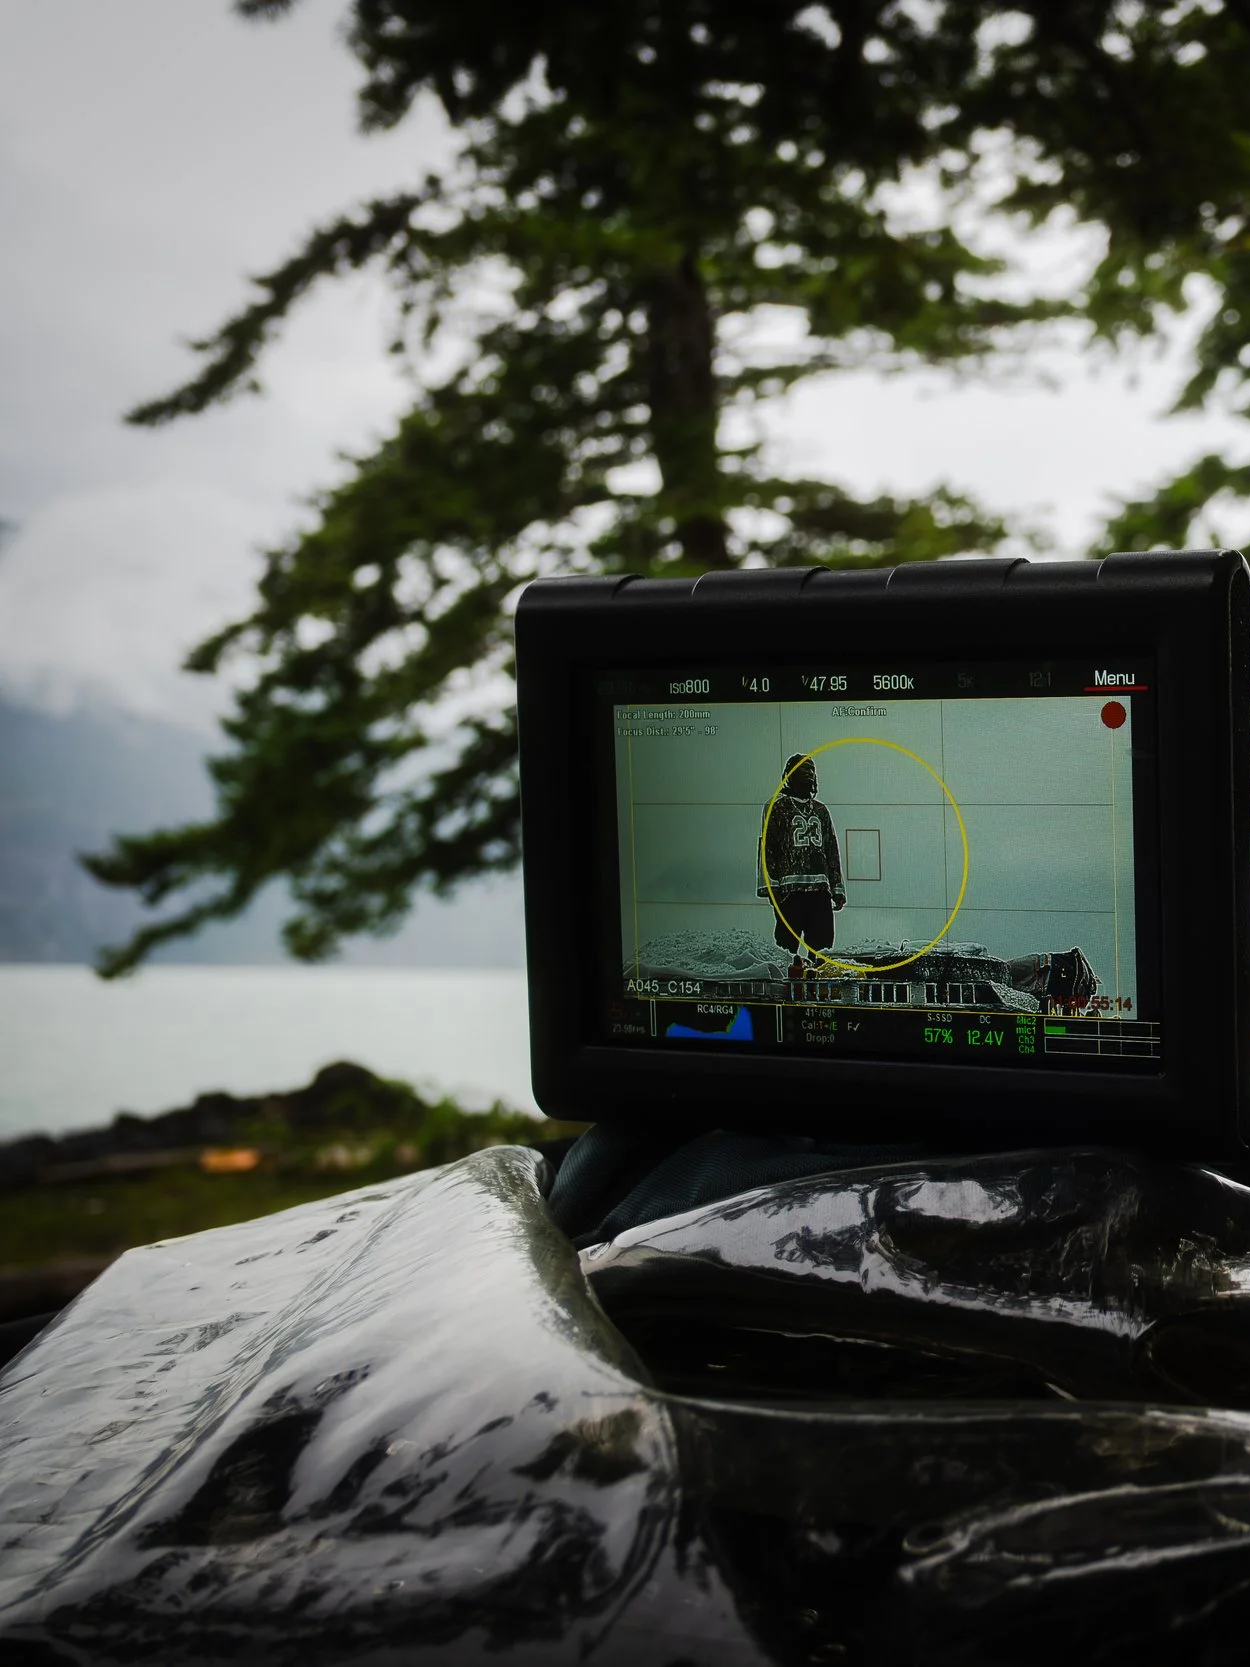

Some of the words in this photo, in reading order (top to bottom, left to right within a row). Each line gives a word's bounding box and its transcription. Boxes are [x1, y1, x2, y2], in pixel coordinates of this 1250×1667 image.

[873, 674, 914, 690] 5600K
[1094, 670, 1135, 685] Menu
[670, 679, 710, 694] ISO800
[617, 710, 641, 720] Focal
[643, 709, 676, 721] Length:
[679, 709, 711, 719] 200mm
[832, 707, 887, 717] AF:Confirm
[617, 727, 643, 737] Focus
[791, 815, 822, 847] 23
[627, 979, 701, 997] A045_C154
[697, 1004, 734, 1015] RC4/RG4
[979, 1015, 991, 1025] DC
[805, 1032, 835, 1044] Drop:0
[924, 1028, 953, 1044] 57%
[967, 1029, 1004, 1046] 12.4V
[1018, 1034, 1035, 1045] Ch3
[1018, 1044, 1035, 1054] Ch4
